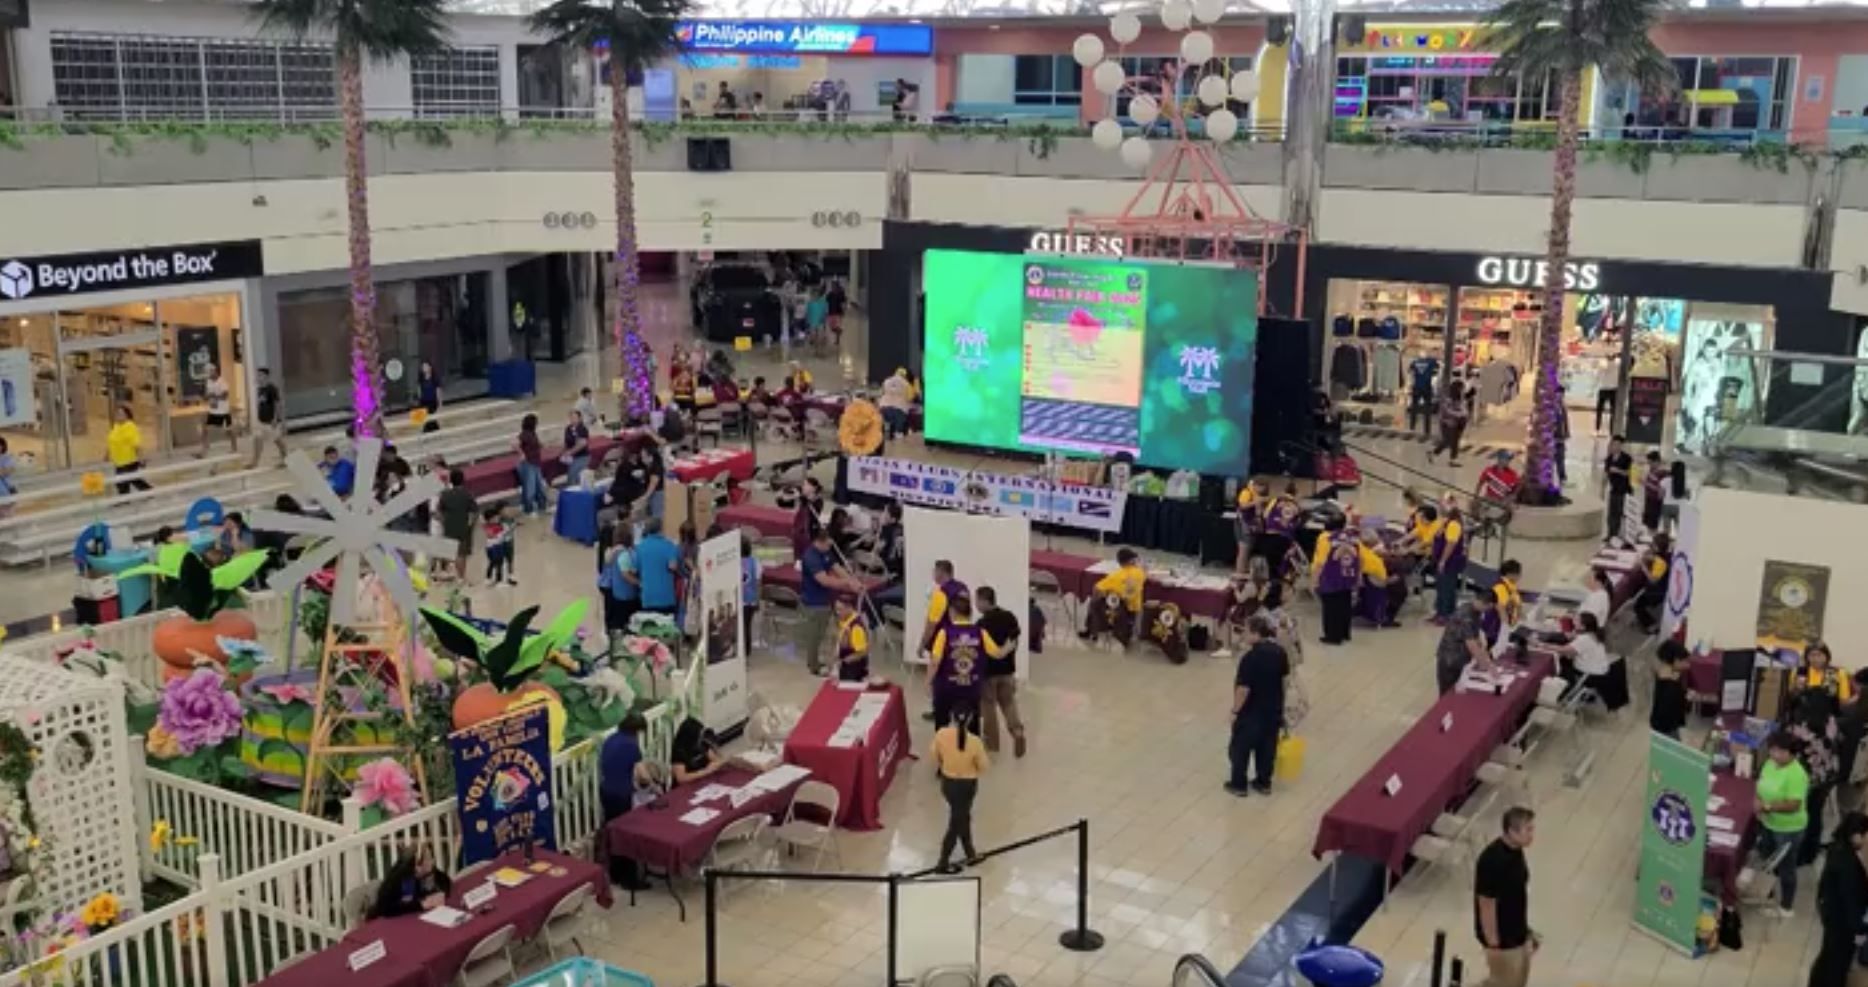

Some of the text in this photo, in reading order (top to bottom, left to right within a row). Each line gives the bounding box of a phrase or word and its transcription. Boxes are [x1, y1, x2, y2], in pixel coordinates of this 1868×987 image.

[695, 23, 856, 45] Philippine Airlines
[38, 252, 214, 291] Beyond the Box
